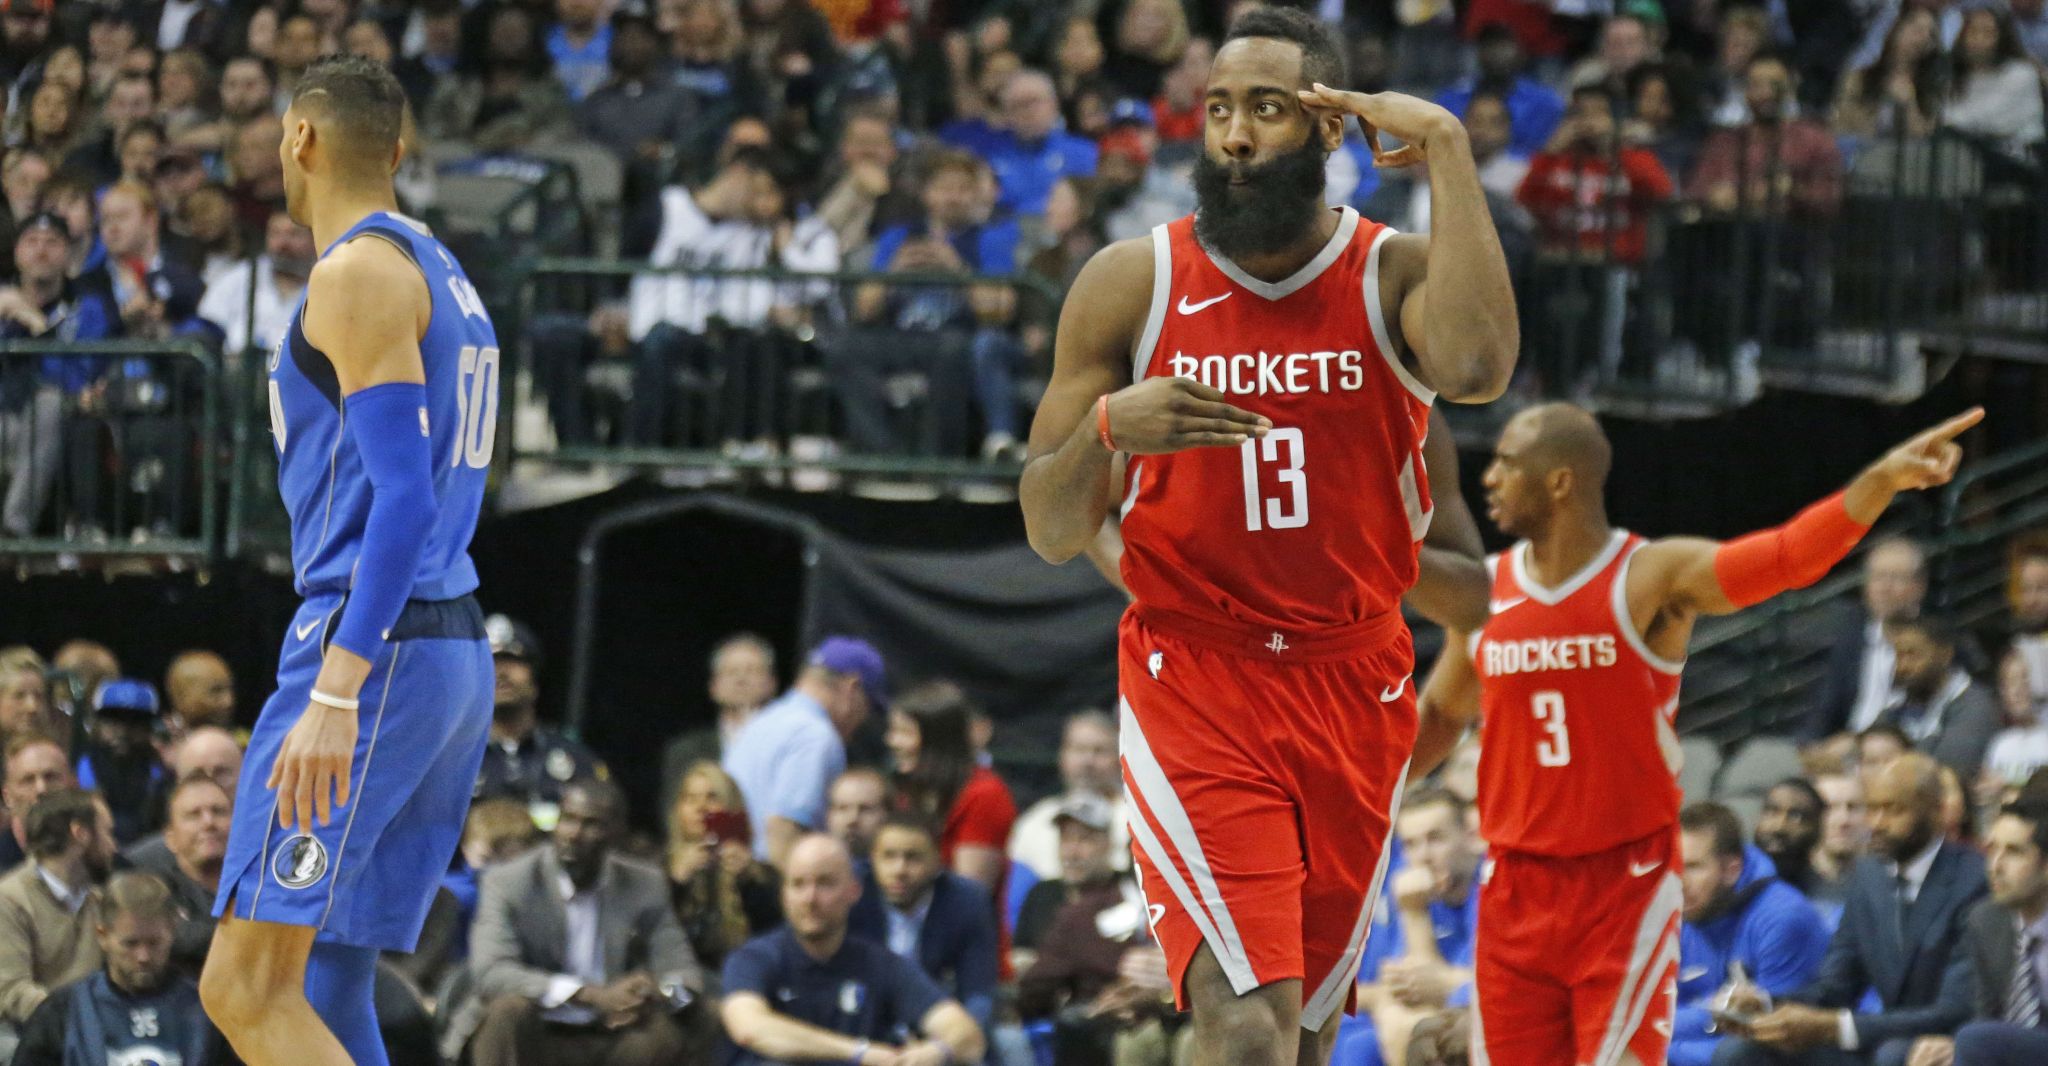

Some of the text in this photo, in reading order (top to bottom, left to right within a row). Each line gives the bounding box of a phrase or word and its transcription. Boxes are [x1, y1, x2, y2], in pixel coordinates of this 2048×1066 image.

[1168, 350, 1363, 396] ROCKETS
[1241, 427, 1309, 531] 13
[1483, 633, 1617, 676] ROCKETS
[1532, 691, 1571, 767] 3
